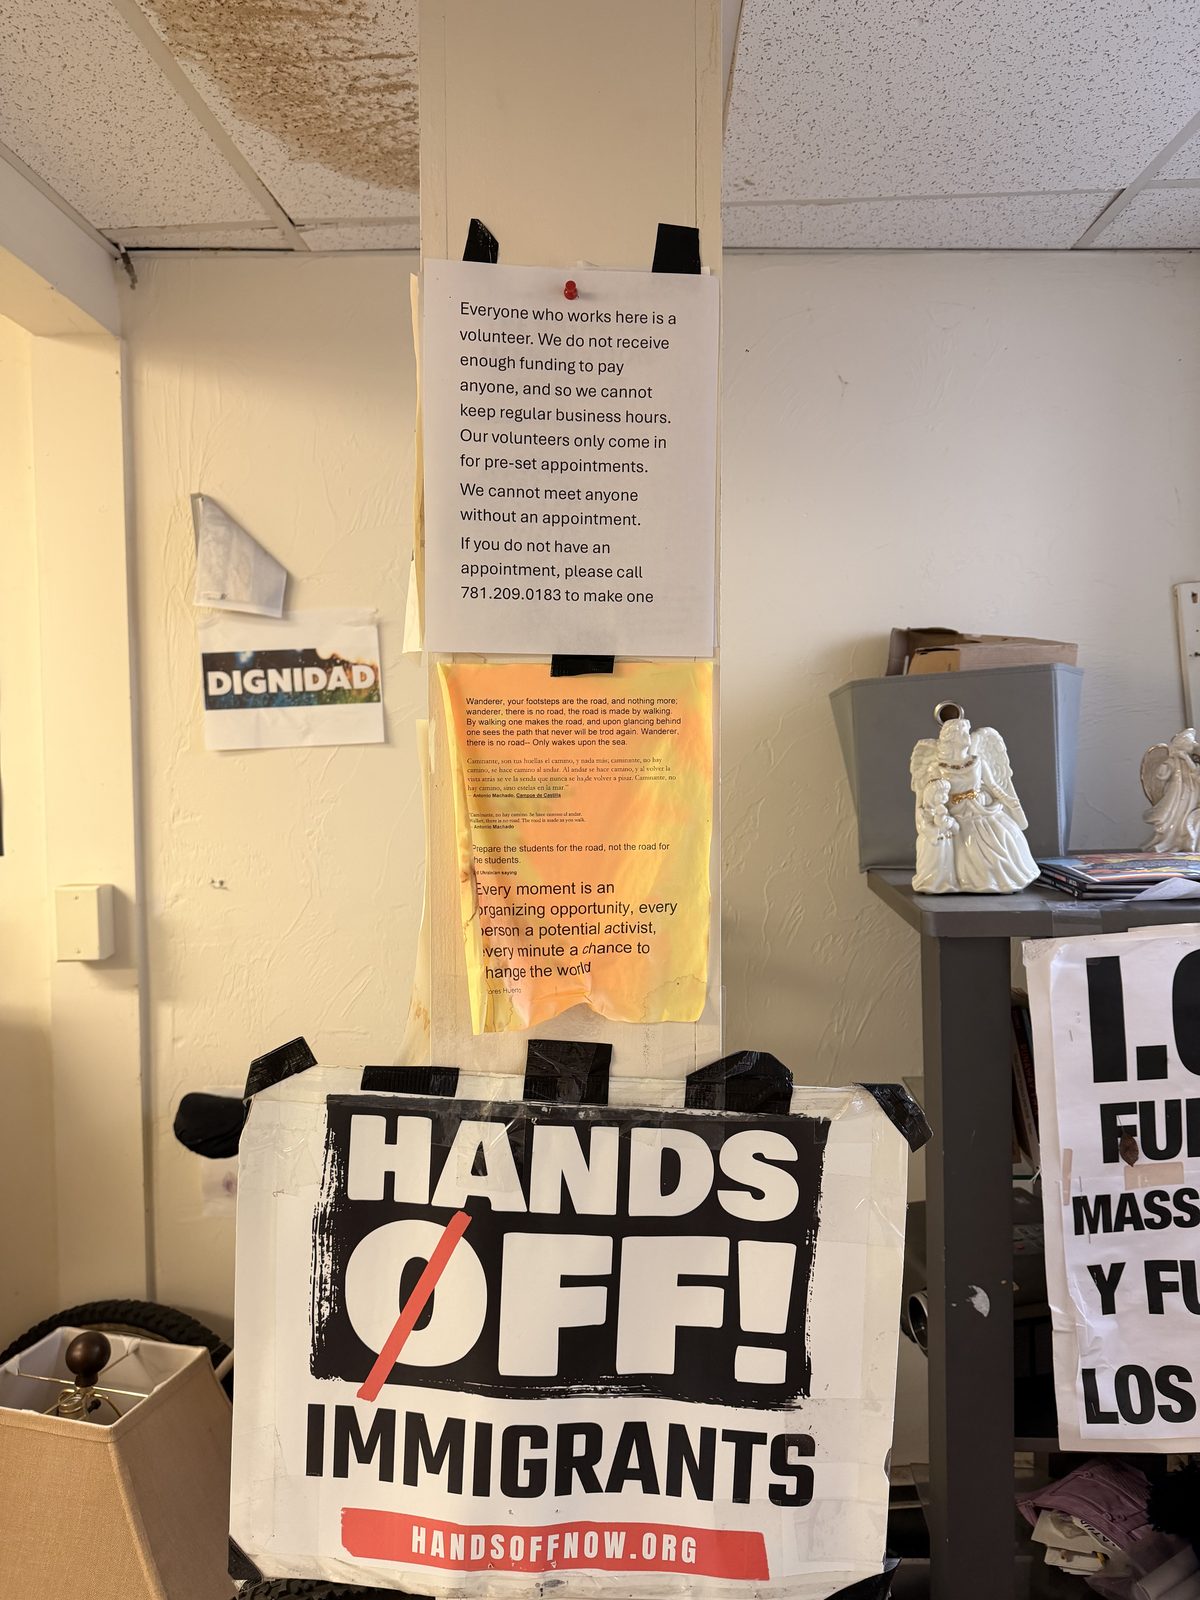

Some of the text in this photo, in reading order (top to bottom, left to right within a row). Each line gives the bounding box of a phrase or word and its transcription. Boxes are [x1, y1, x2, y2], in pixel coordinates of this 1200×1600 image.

[461, 302, 676, 326] Everyone who works here is a
[460, 329, 669, 351] volunteer. We do not receive
[460, 352, 624, 376] enough funding to pay
[460, 380, 652, 399] anyone, and so we cannot
[461, 402, 671, 424] keep regular business hours.
[460, 429, 666, 450] Our volunteers only come in
[460, 454, 648, 474] for pre-set appointments.
[460, 483, 638, 504] We cannot meet anyone
[460, 506, 640, 527] without an appointment.
[462, 537, 610, 556] If you do not have an
[461, 561, 643, 581] appointment, please call
[461, 586, 653, 603] 781.209.0183 to make one
[207, 664, 375, 696] DIGNIDAD
[505, 707, 525, 715] there
[609, 707, 631, 715] made
[632, 707, 641, 716] by
[643, 707, 672, 716] walking.
[526, 698, 560, 706] footsteps
[628, 698, 654, 706] nothing
[466, 728, 480, 736] one
[517, 729, 533, 737] path
[616, 728, 638, 737] again.
[467, 718, 476, 728] By
[478, 718, 506, 727] walking
[623, 717, 654, 726] glancing
[655, 717, 681, 725] behind
[467, 738, 486, 746] there
[533, 739, 549, 747] Only
[556, 844, 567, 852] for
[585, 844, 606, 852] road,
[473, 855, 521, 865] he students.
[475, 881, 614, 899] Every moment is an
[551, 901, 633, 918] opportunity,
[639, 903, 677, 915] every
[523, 925, 533, 936] a
[539, 922, 600, 939] potential
[604, 921, 656, 935] activist,
[483, 942, 650, 960] very minute a chance to
[486, 962, 591, 982] hange the world
[347, 1114, 799, 1222] HANDS
[1072, 1187, 1200, 1236] MASS
[1087, 1262, 1126, 1315] Y
[344, 1219, 797, 1385] OFF!
[1081, 1364, 1197, 1424] LOS
[306, 1403, 816, 1508] IMMIGRANTS
[411, 1525, 697, 1564] HANDSOFFNOW.ORG
